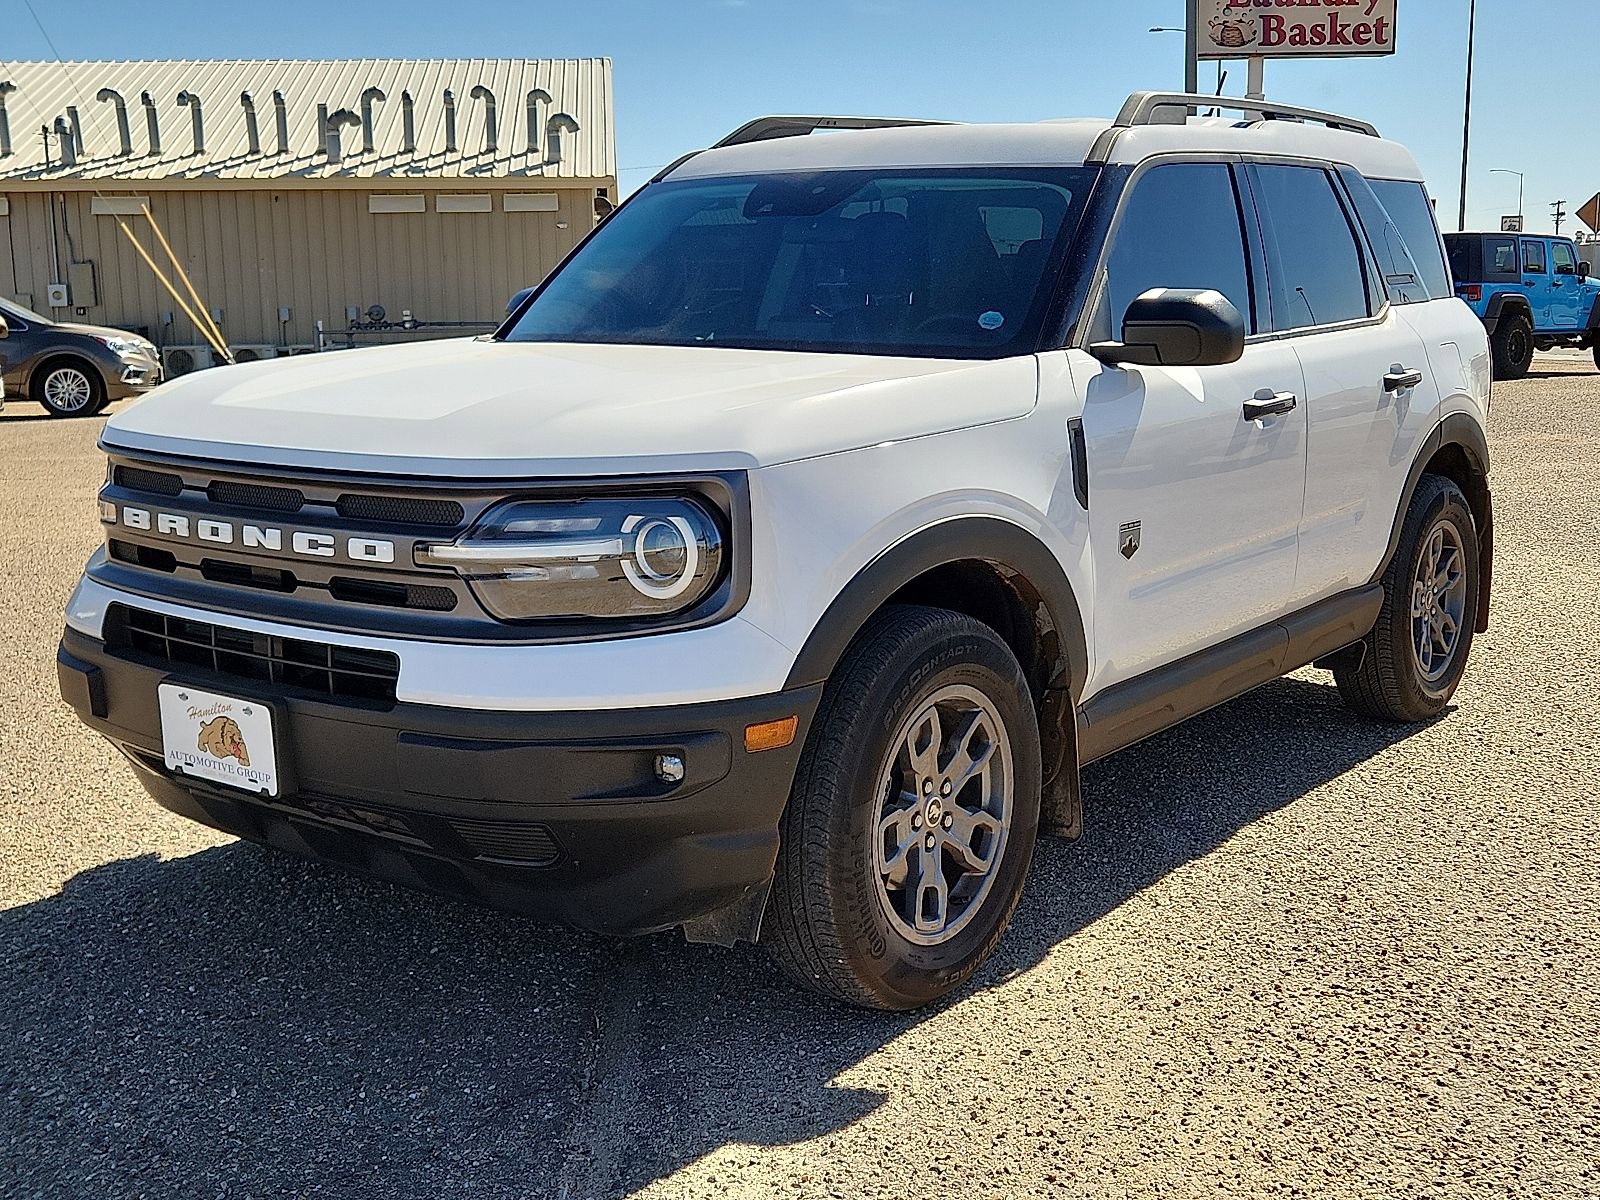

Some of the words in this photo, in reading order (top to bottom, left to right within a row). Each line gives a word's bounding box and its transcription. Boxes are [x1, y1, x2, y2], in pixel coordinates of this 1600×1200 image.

[1257, 12, 1389, 46] Basket
[123, 506, 395, 563] BRONCO
[187, 702, 233, 720] Hamilton
[169, 750, 235, 774] AUTOMOTIVE
[236, 766, 271, 783] GROUP
